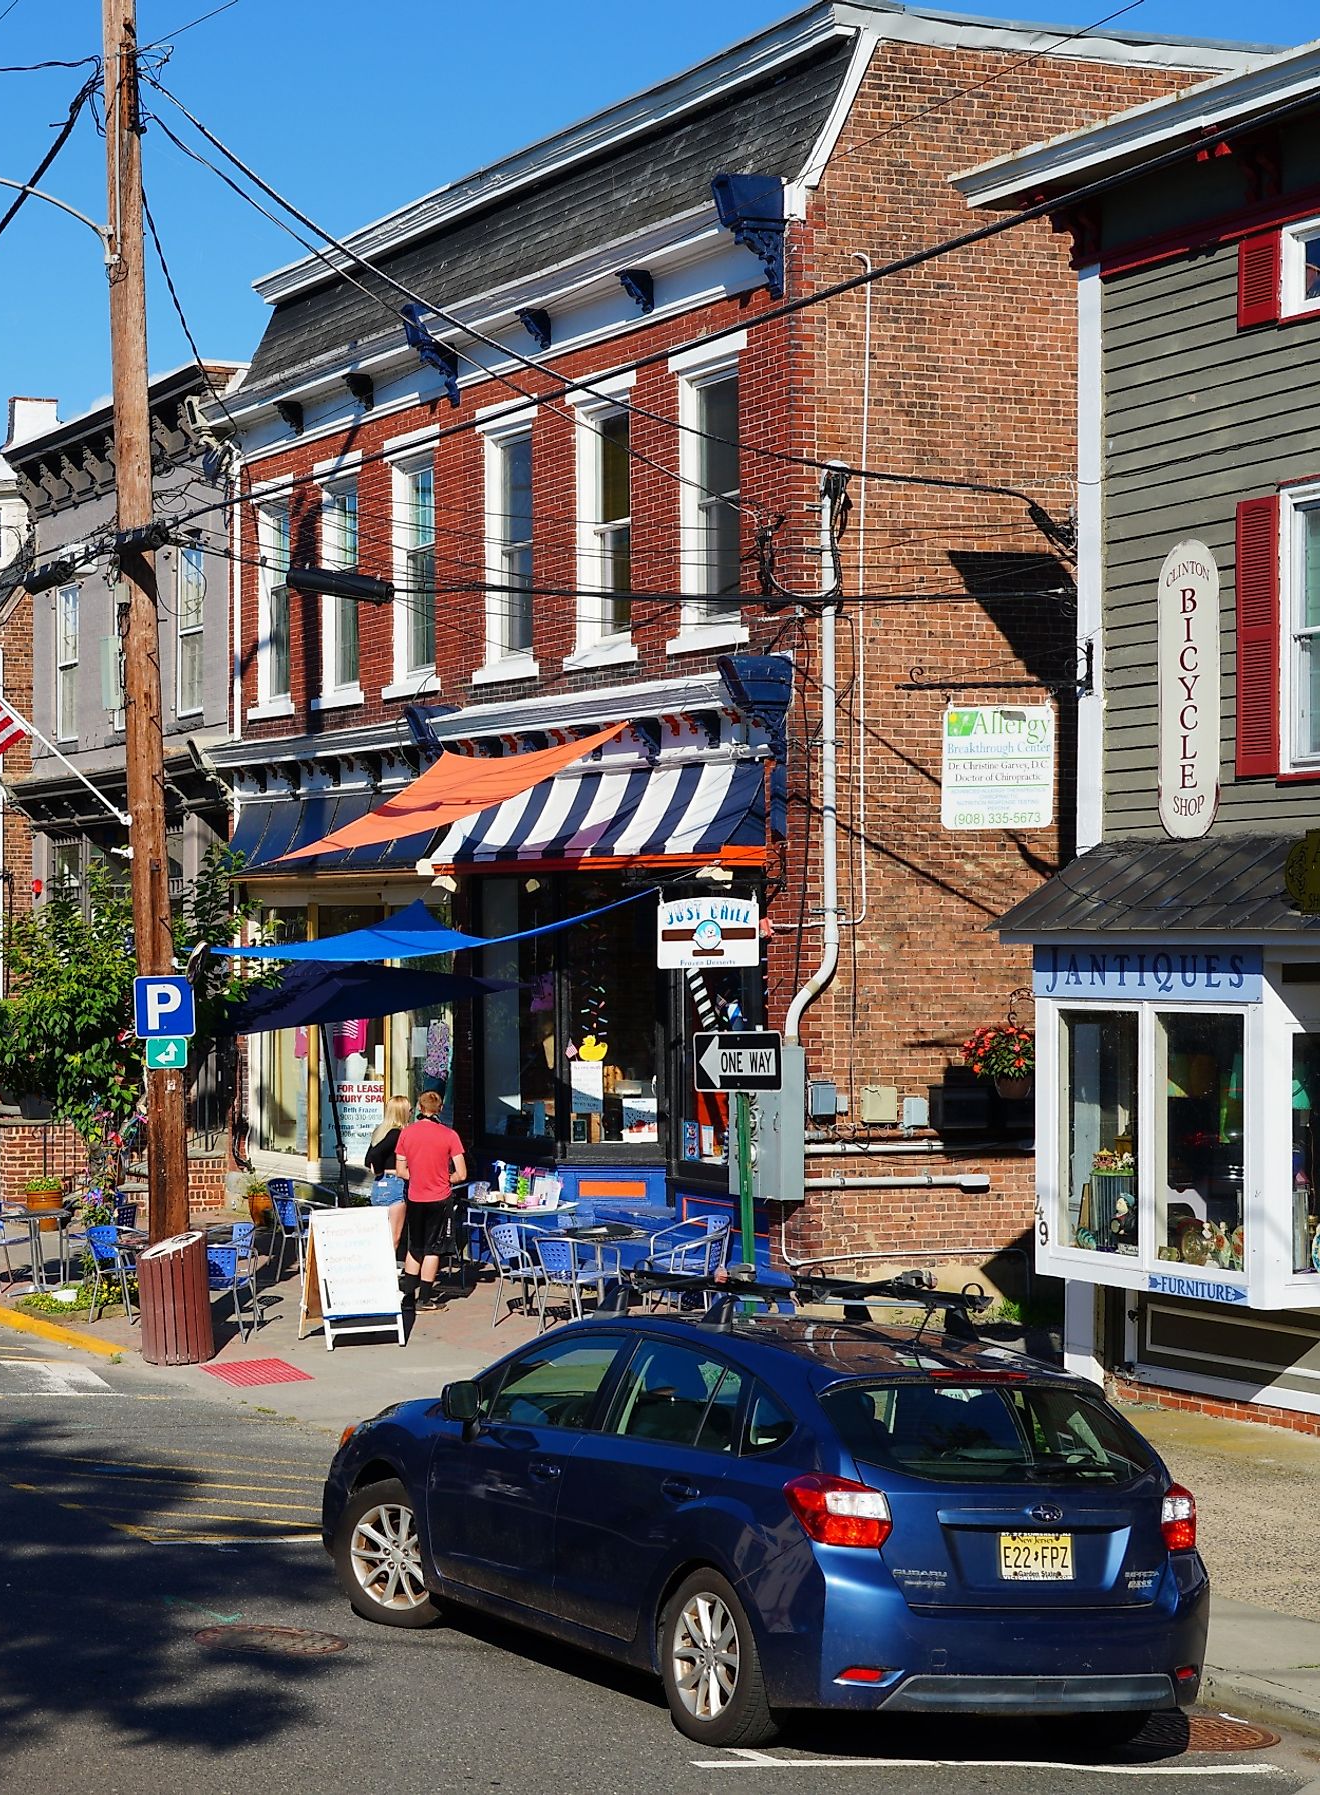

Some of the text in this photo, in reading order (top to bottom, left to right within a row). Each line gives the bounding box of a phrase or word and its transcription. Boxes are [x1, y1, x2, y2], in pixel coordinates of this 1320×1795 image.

[1166, 561, 1210, 587] CLINTON
[1178, 588, 1200, 789] BICYCLE
[974, 711, 1050, 744] Allergy
[947, 741, 1051, 757] Breakthrough Center
[948, 760, 1049, 772] Dr. Christine Garvey, D.C.
[955, 772, 1041, 784] Doctor of Chiropractic
[1173, 795, 1204, 816] SHOP
[954, 812, 1041, 826] (908) 335-5673
[667, 902, 750, 925] JUST CHILL
[1046, 947, 1244, 993] JANTIQUES
[147, 984, 181, 1030] P
[721, 1052, 772, 1073] ONE WAY
[337, 1085, 384, 1093] FOR LEASE
[1160, 1276, 1233, 1301] FURNITURE
[1033, 1536, 1054, 1545] Jersey
[1004, 1547, 1069, 1568] E22 FPZ
[893, 1569, 948, 1577] SUBARU
